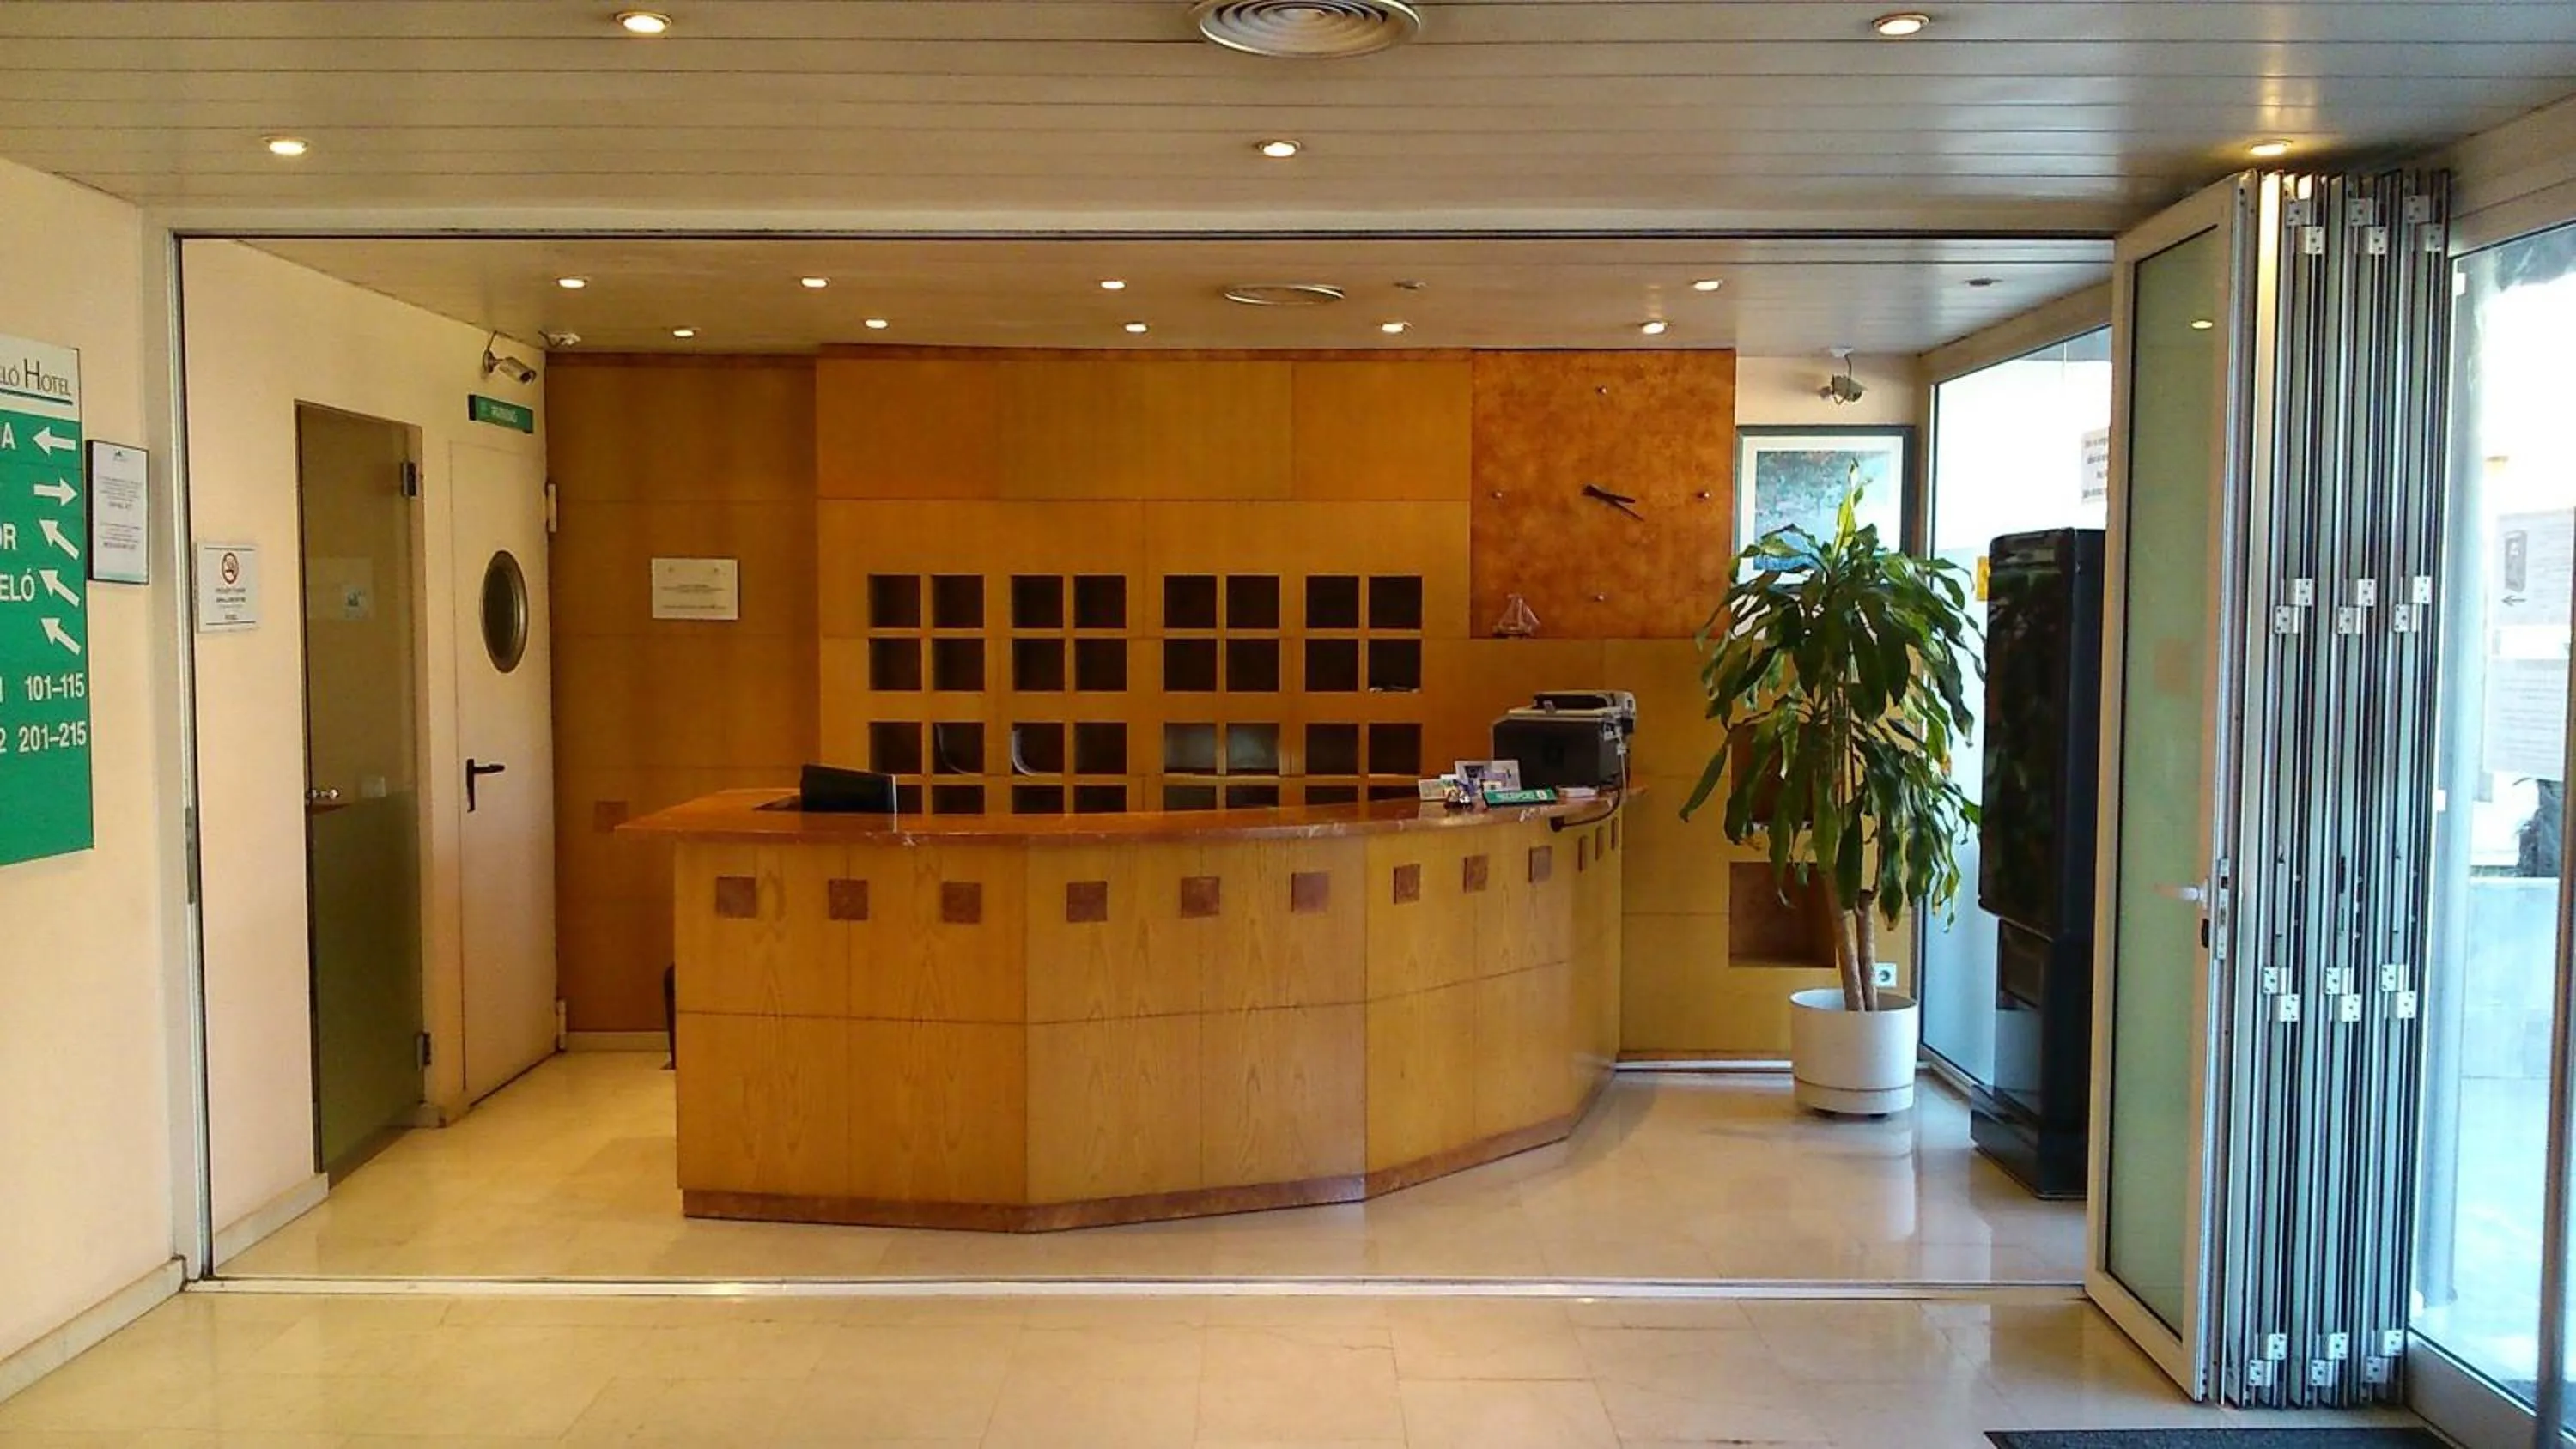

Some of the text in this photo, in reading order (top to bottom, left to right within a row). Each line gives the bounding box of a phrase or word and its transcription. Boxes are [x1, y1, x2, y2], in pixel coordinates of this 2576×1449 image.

[0, 358, 71, 397] LÓ HOTEL
[0, 523, 17, 550] R
[24, 673, 85, 701] 101-115
[18, 721, 87, 753] 201-215
